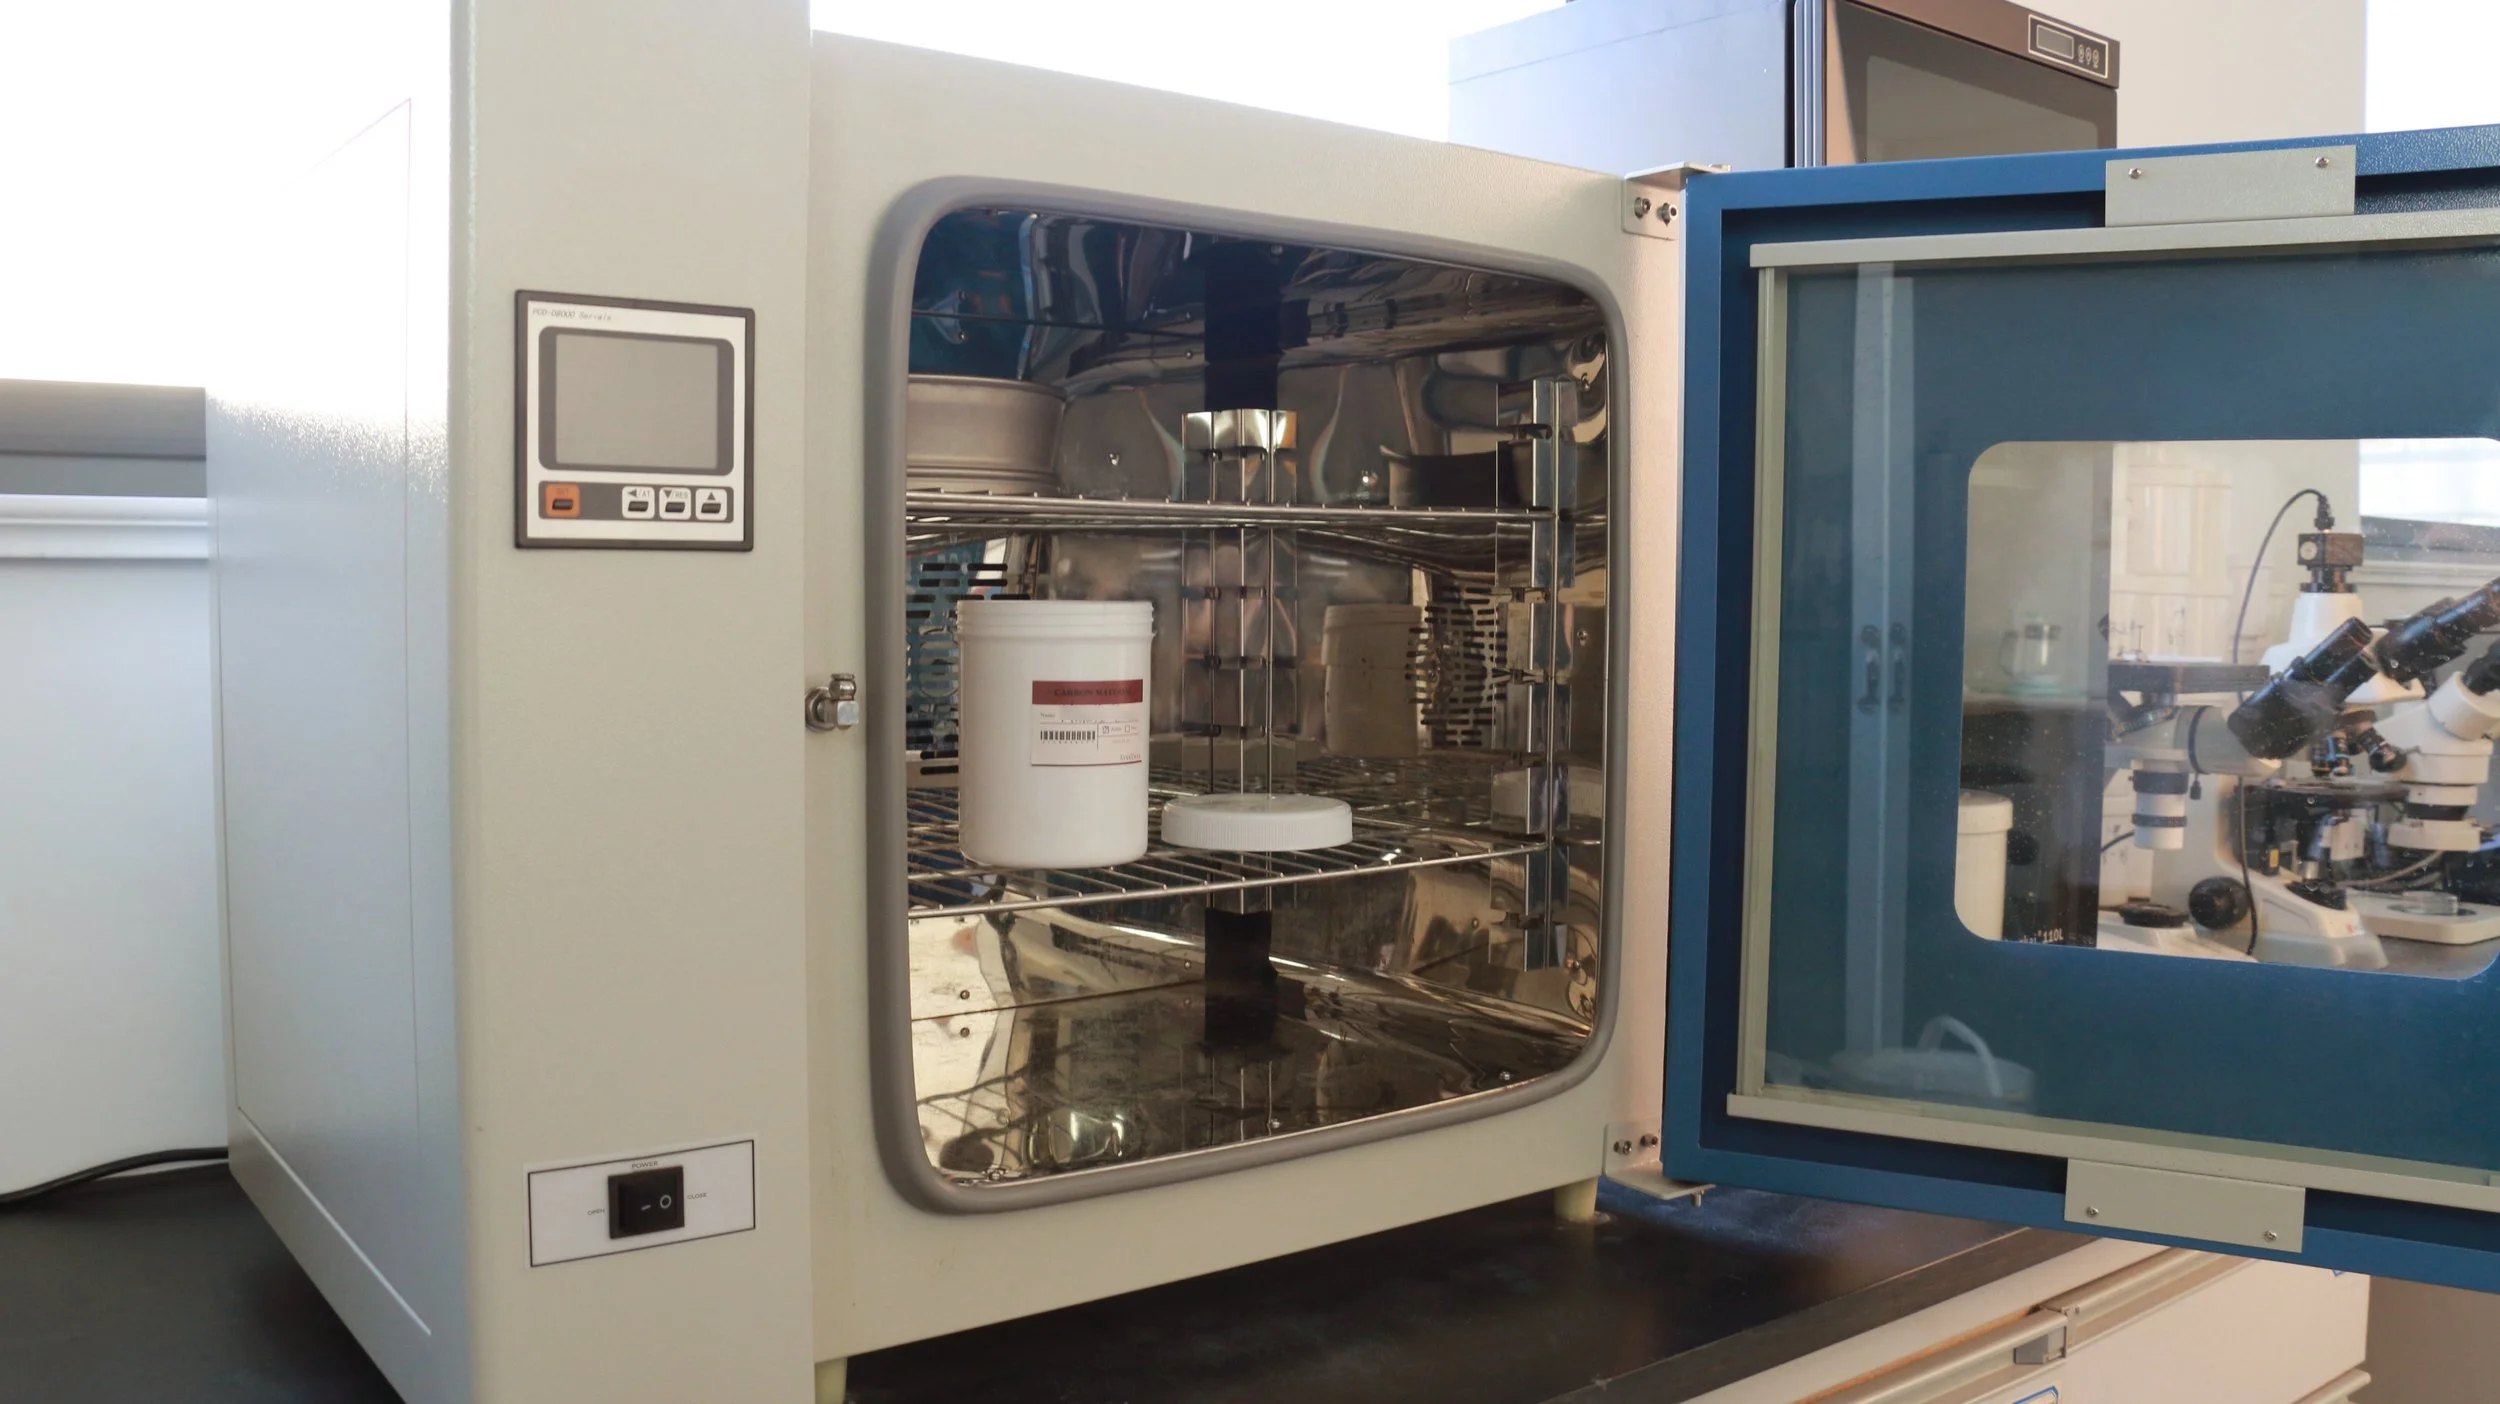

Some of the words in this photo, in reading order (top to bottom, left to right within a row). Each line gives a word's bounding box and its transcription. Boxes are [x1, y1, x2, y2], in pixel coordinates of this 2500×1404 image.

[631, 1161, 659, 1170] POWER
[687, 1192, 708, 1200] CLOSE
[587, 1208, 606, 1216] OPEN
